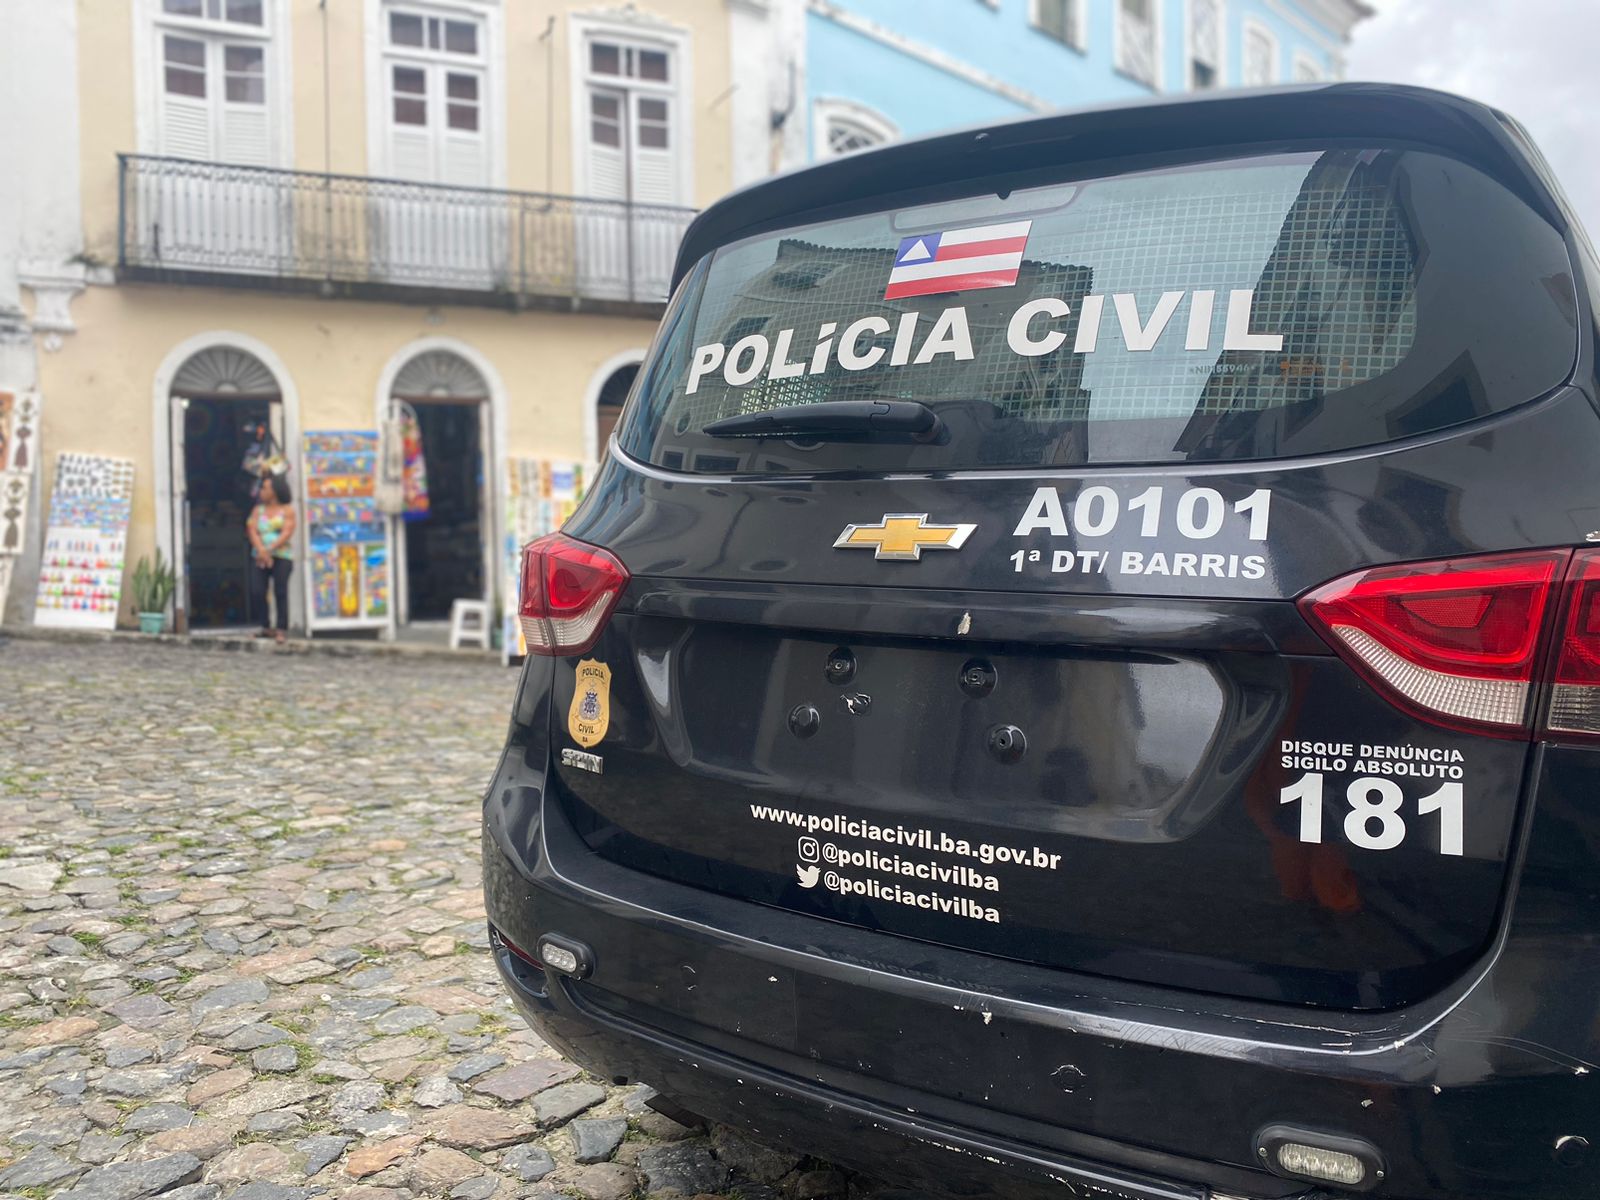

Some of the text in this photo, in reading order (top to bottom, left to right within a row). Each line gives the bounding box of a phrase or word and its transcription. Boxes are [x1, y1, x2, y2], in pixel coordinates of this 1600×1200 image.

[1006, 289, 1284, 356] CIVIL
[1012, 486, 1272, 541] A0101
[1051, 551, 1109, 574] DT/
[1119, 551, 1266, 580] BARRIS
[578, 723, 595, 734] CIVIL
[1281, 740, 1465, 763] DISQUE DENÚNCIA
[1281, 755, 1464, 780] SIGILO ABSOLUTO
[750, 804, 1062, 870] www.policiacivil.ba.gov.br
[1279, 772, 1464, 856] 181
[822, 842, 1000, 892] @policiacivilba
[823, 871, 1001, 924] @policiacivilba
